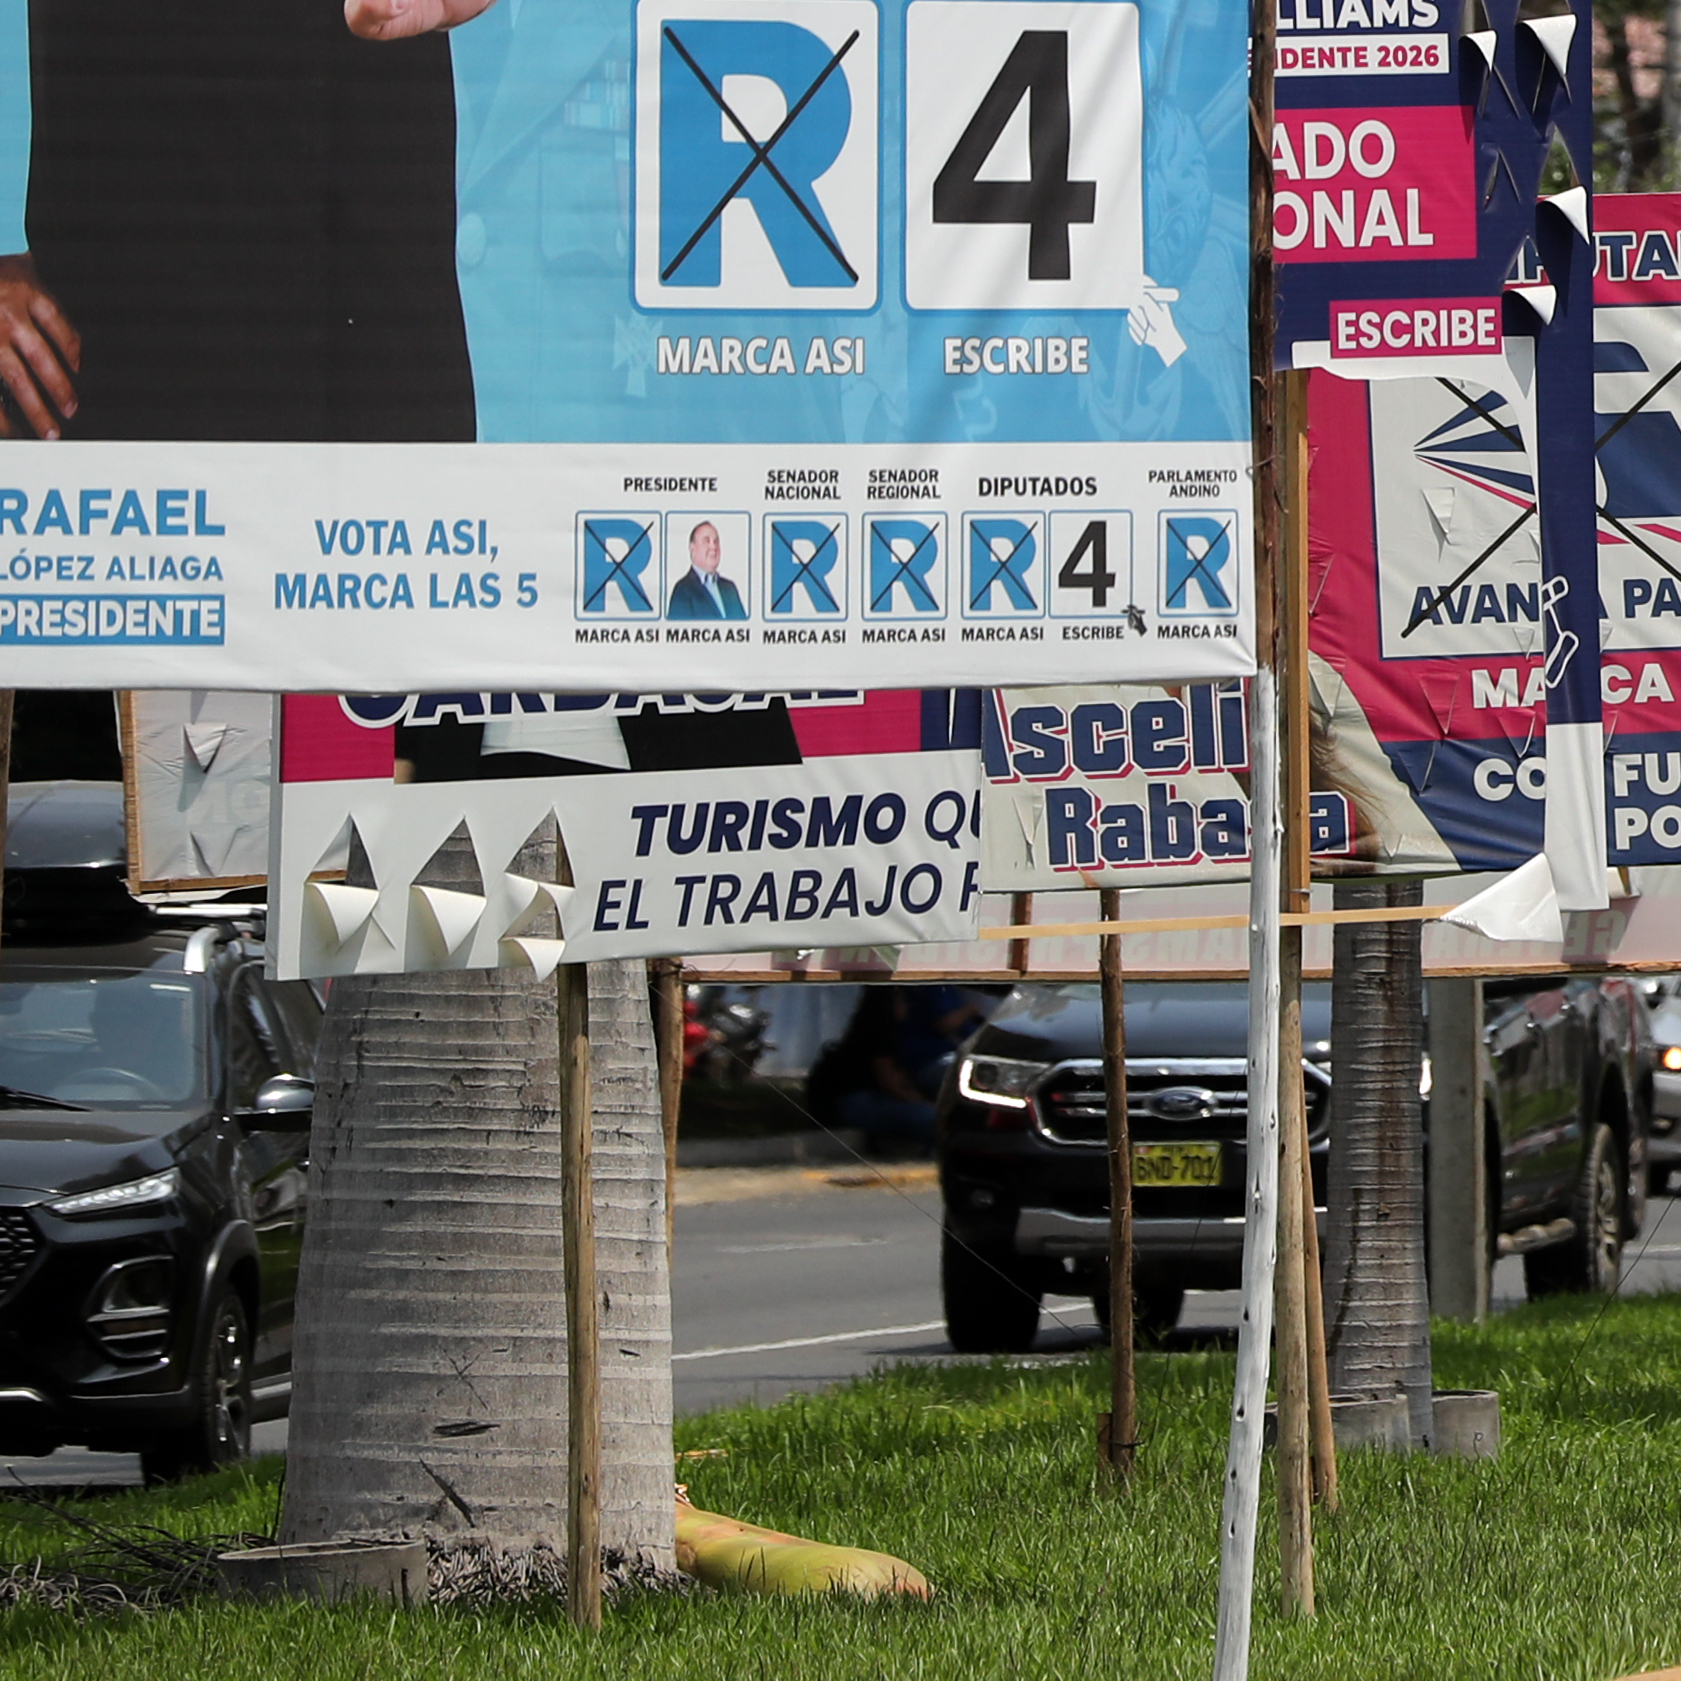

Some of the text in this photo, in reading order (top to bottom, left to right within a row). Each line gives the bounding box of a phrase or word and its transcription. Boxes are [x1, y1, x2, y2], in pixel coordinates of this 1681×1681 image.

[1377, 44, 1440, 68] 2026
[932, 29, 1097, 283] 4
[1337, 308, 1496, 350] ESCRIBE
[655, 335, 866, 377] MARCA ASI
[942, 335, 1090, 376] ESCRIBE
[623, 476, 718, 493] PRESIDENTE
[767, 469, 839, 486] SENADOR
[868, 469, 939, 486] SENADOR
[978, 476, 1098, 498] DIPUTADOS
[1148, 469, 1238, 485] PARLAMENTO
[764, 485, 841, 502] NACIONAL
[867, 484, 941, 501] REGIONAL
[1168, 483, 1222, 499] ANDINO
[0, 487, 226, 538] RAFAEL
[314, 518, 500, 563] VOTA ASI,
[105, 555, 224, 582] ALIAGA
[1057, 520, 1117, 608] 4
[274, 572, 539, 610] MARCA LAS 5
[0, 598, 222, 638] PRESIDENTE
[575, 628, 659, 644] MARCA ASI
[666, 627, 750, 644] MARCA ASI
[763, 628, 846, 645] MARCA ASI
[862, 628, 946, 644] MARCA ASI
[961, 626, 1045, 642] MARCA ASI
[1062, 625, 1124, 642] ESCRIBE
[1157, 624, 1238, 640] MARCA ASI
[1471, 663, 1676, 710] MACA
[631, 793, 906, 857] TURISMO
[1044, 782, 1352, 867] Rabaa
[593, 863, 943, 932] EL TRABAJO
